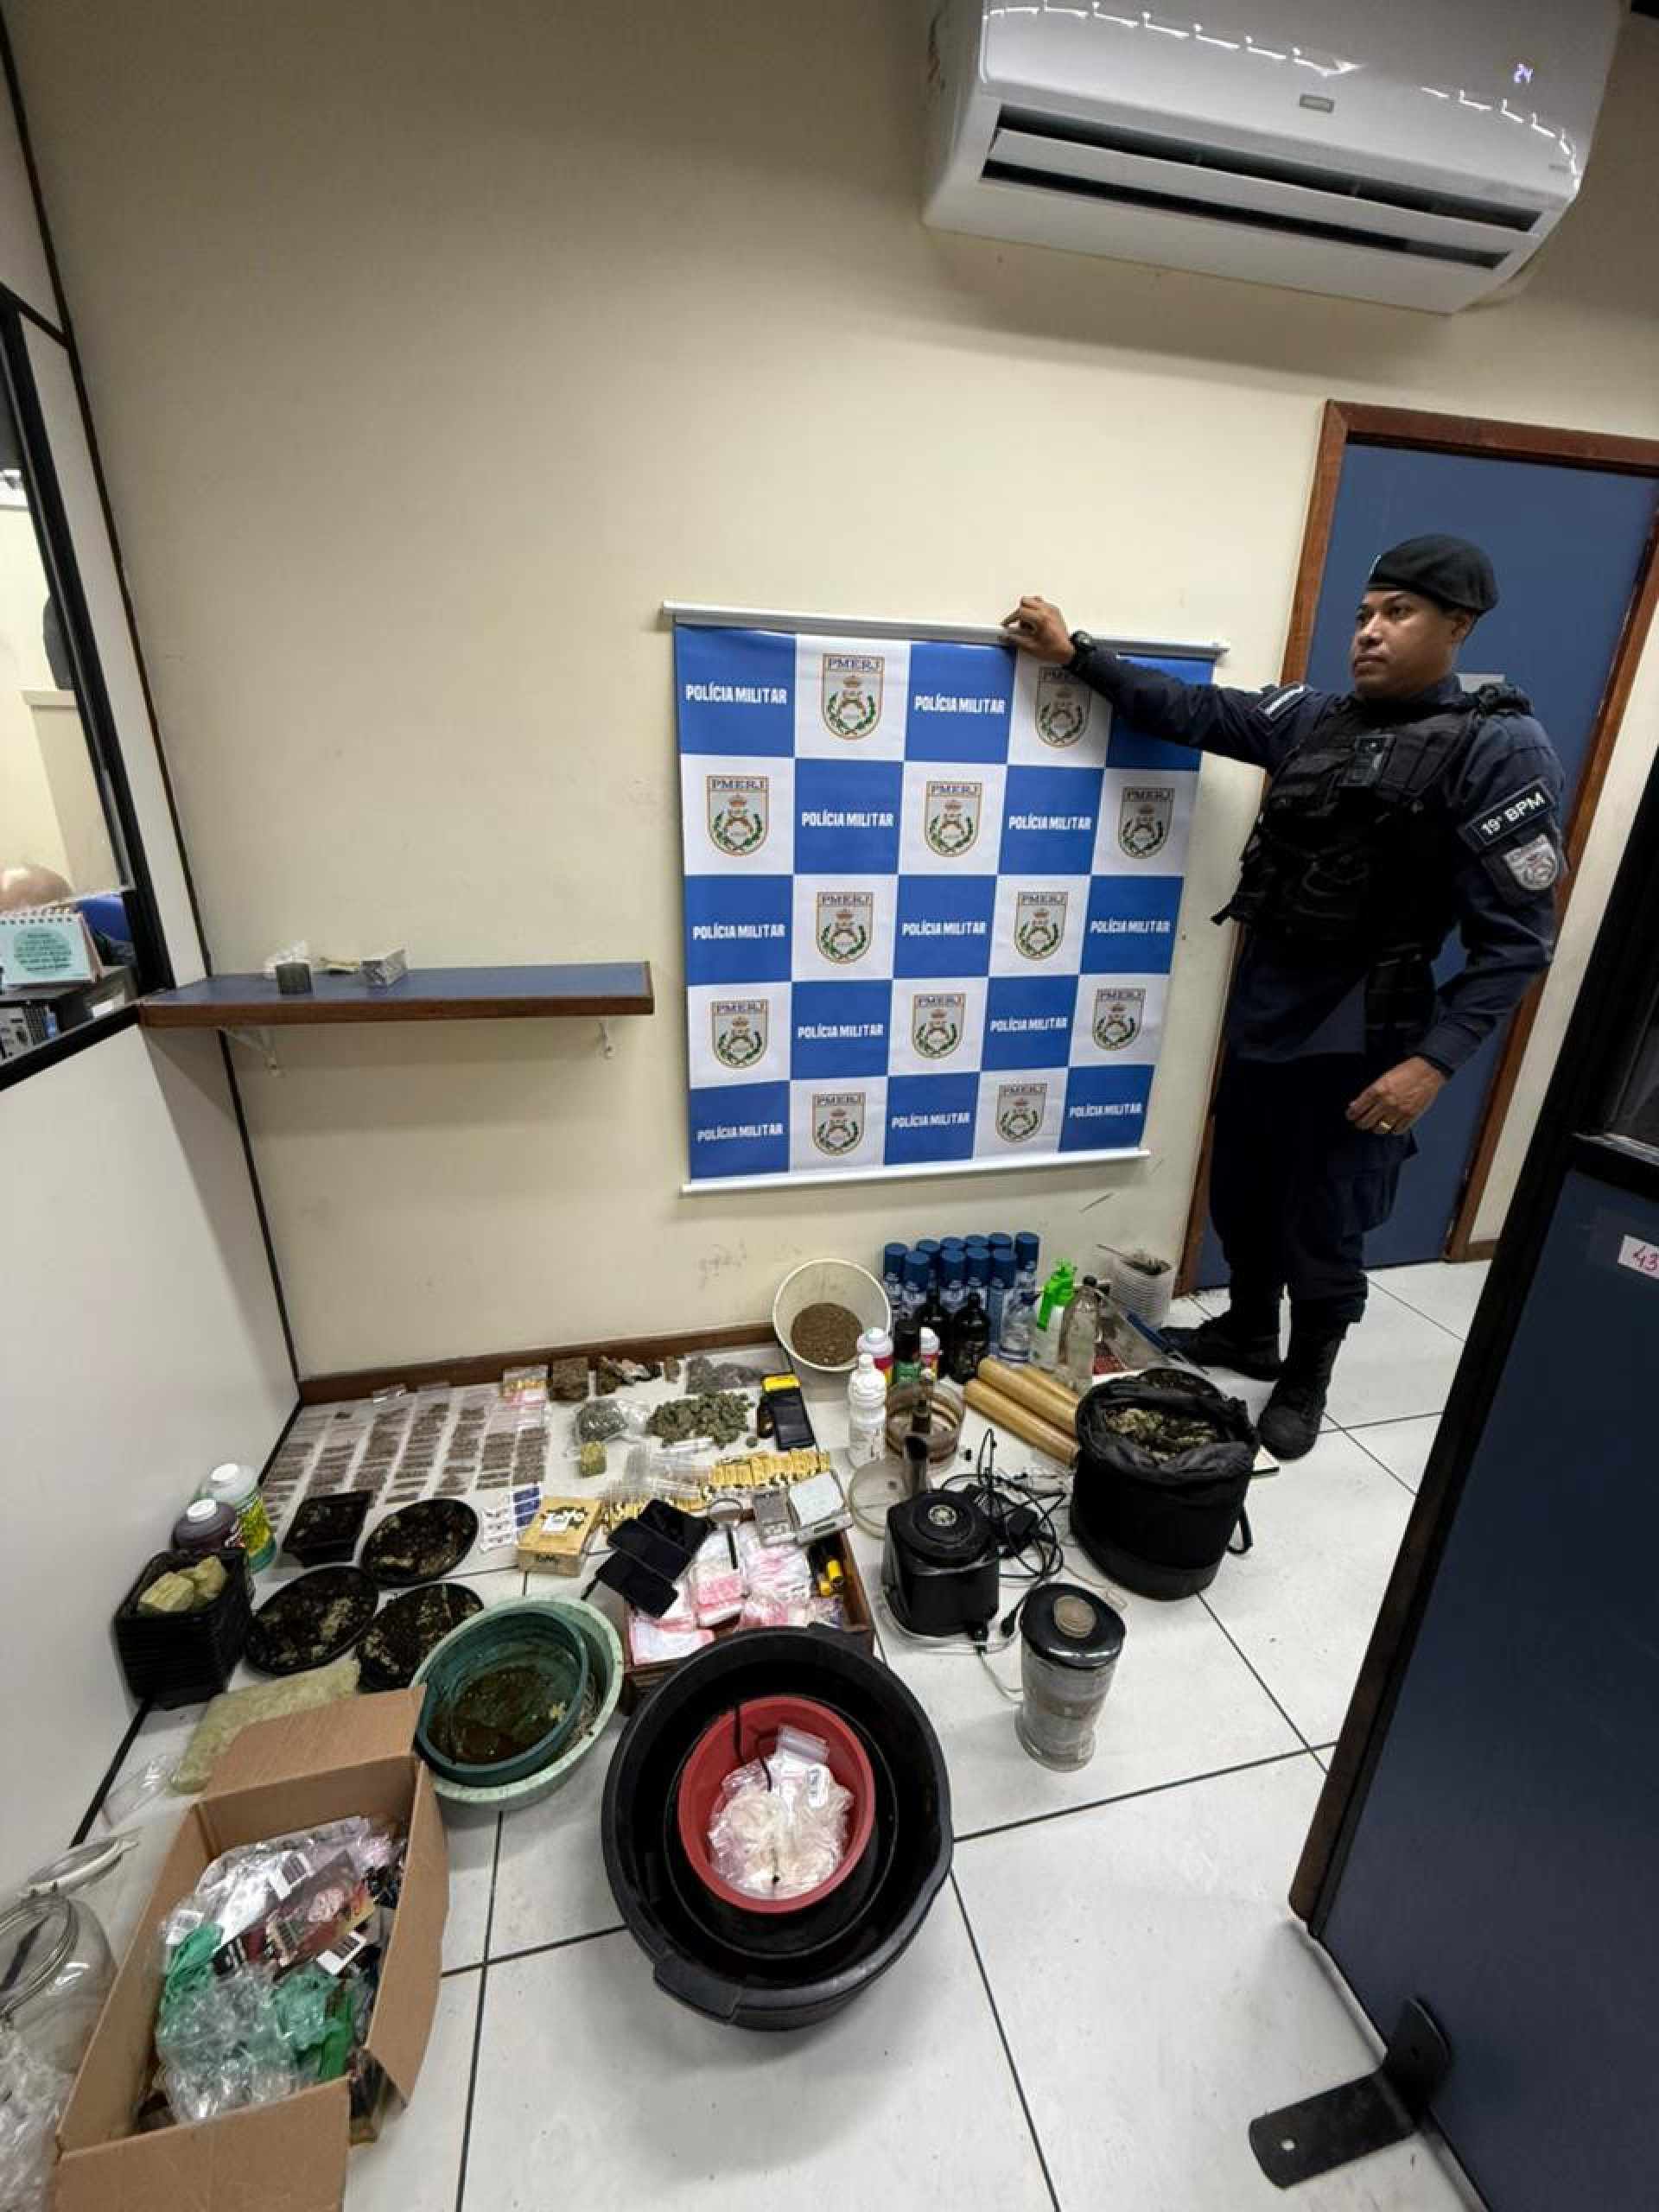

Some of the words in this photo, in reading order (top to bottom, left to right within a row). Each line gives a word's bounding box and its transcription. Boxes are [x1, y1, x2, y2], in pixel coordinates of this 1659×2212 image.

[828, 658, 879, 670] PMERJ
[686, 681, 733, 702] POLÍCIA
[734, 686, 786, 704] MILITAR
[914, 693, 957, 712] POLÍCIA
[958, 698, 1006, 714] MILITAR
[713, 779, 764, 790] PMERJ
[932, 785, 977, 795] PMERJ
[1127, 791, 1171, 799] PMERJ
[1504, 791, 1545, 822] BPM
[802, 809, 844, 826] POLÍCIA
[846, 812, 893, 828] MILITAR
[1009, 814, 1046, 830] POLÍCIA
[1049, 817, 1090, 830] MILITAR
[693, 923, 735, 940] POLÍCIA
[738, 925, 785, 938] MILITAR
[902, 919, 941, 936] POLÍCIA
[943, 921, 987, 935] MILITAR
[1090, 919, 1126, 933] POLÍCIA
[1128, 921, 1170, 931] MILITAR
[798, 1023, 837, 1039] POLÍCIA
[839, 1023, 883, 1037] MILITAR
[990, 1018, 1026, 1032] POLÍCIA
[1028, 1018, 1067, 1030] MILITAR
[1070, 1106, 1102, 1116] POLÍCIA
[1104, 1104, 1141, 1115] MILITAR
[892, 1115, 927, 1128] POLÍCIA
[930, 1113, 969, 1125] MILITAR
[698, 1127, 735, 1141] POLÍCIA
[737, 1123, 783, 1137] MILITAR
